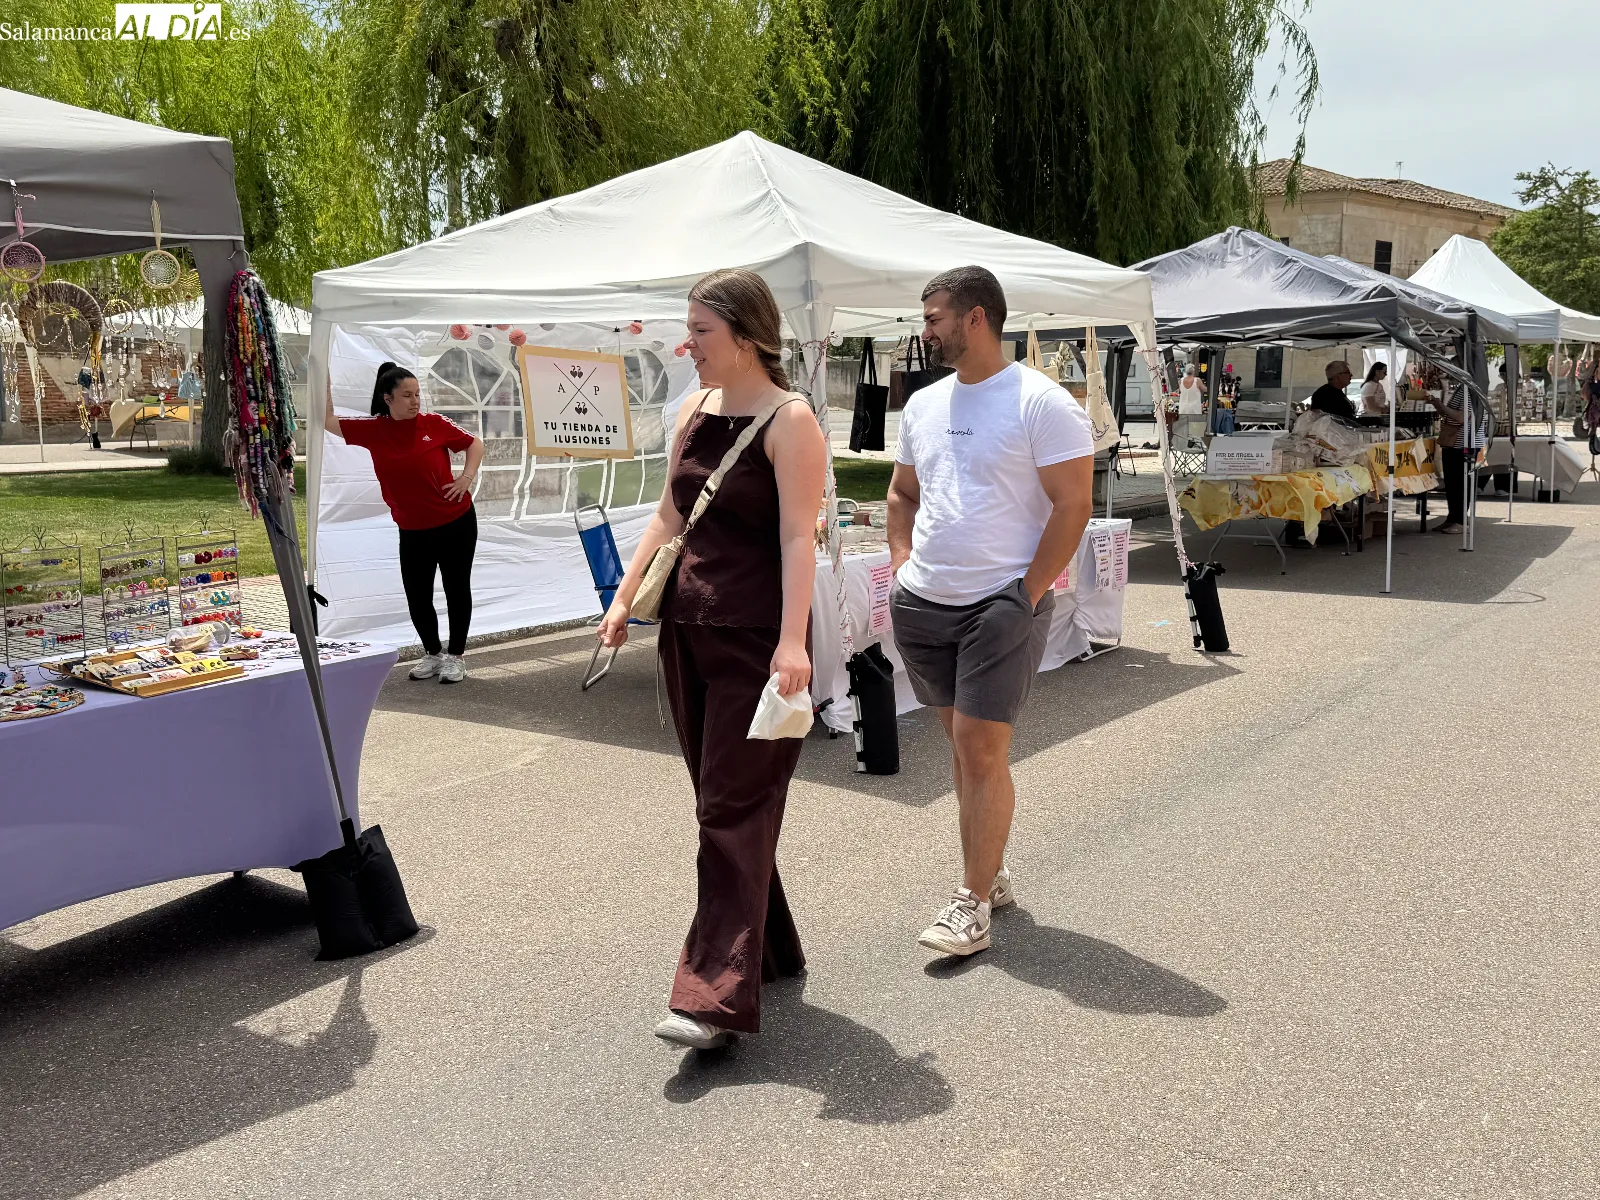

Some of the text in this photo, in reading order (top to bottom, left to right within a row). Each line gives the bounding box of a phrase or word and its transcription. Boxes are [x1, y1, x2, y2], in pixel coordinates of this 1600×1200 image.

[557, 382, 600, 396] A P
[543, 421, 618, 434] TU TIENDA DE
[554, 434, 611, 446] ILUSIONES
